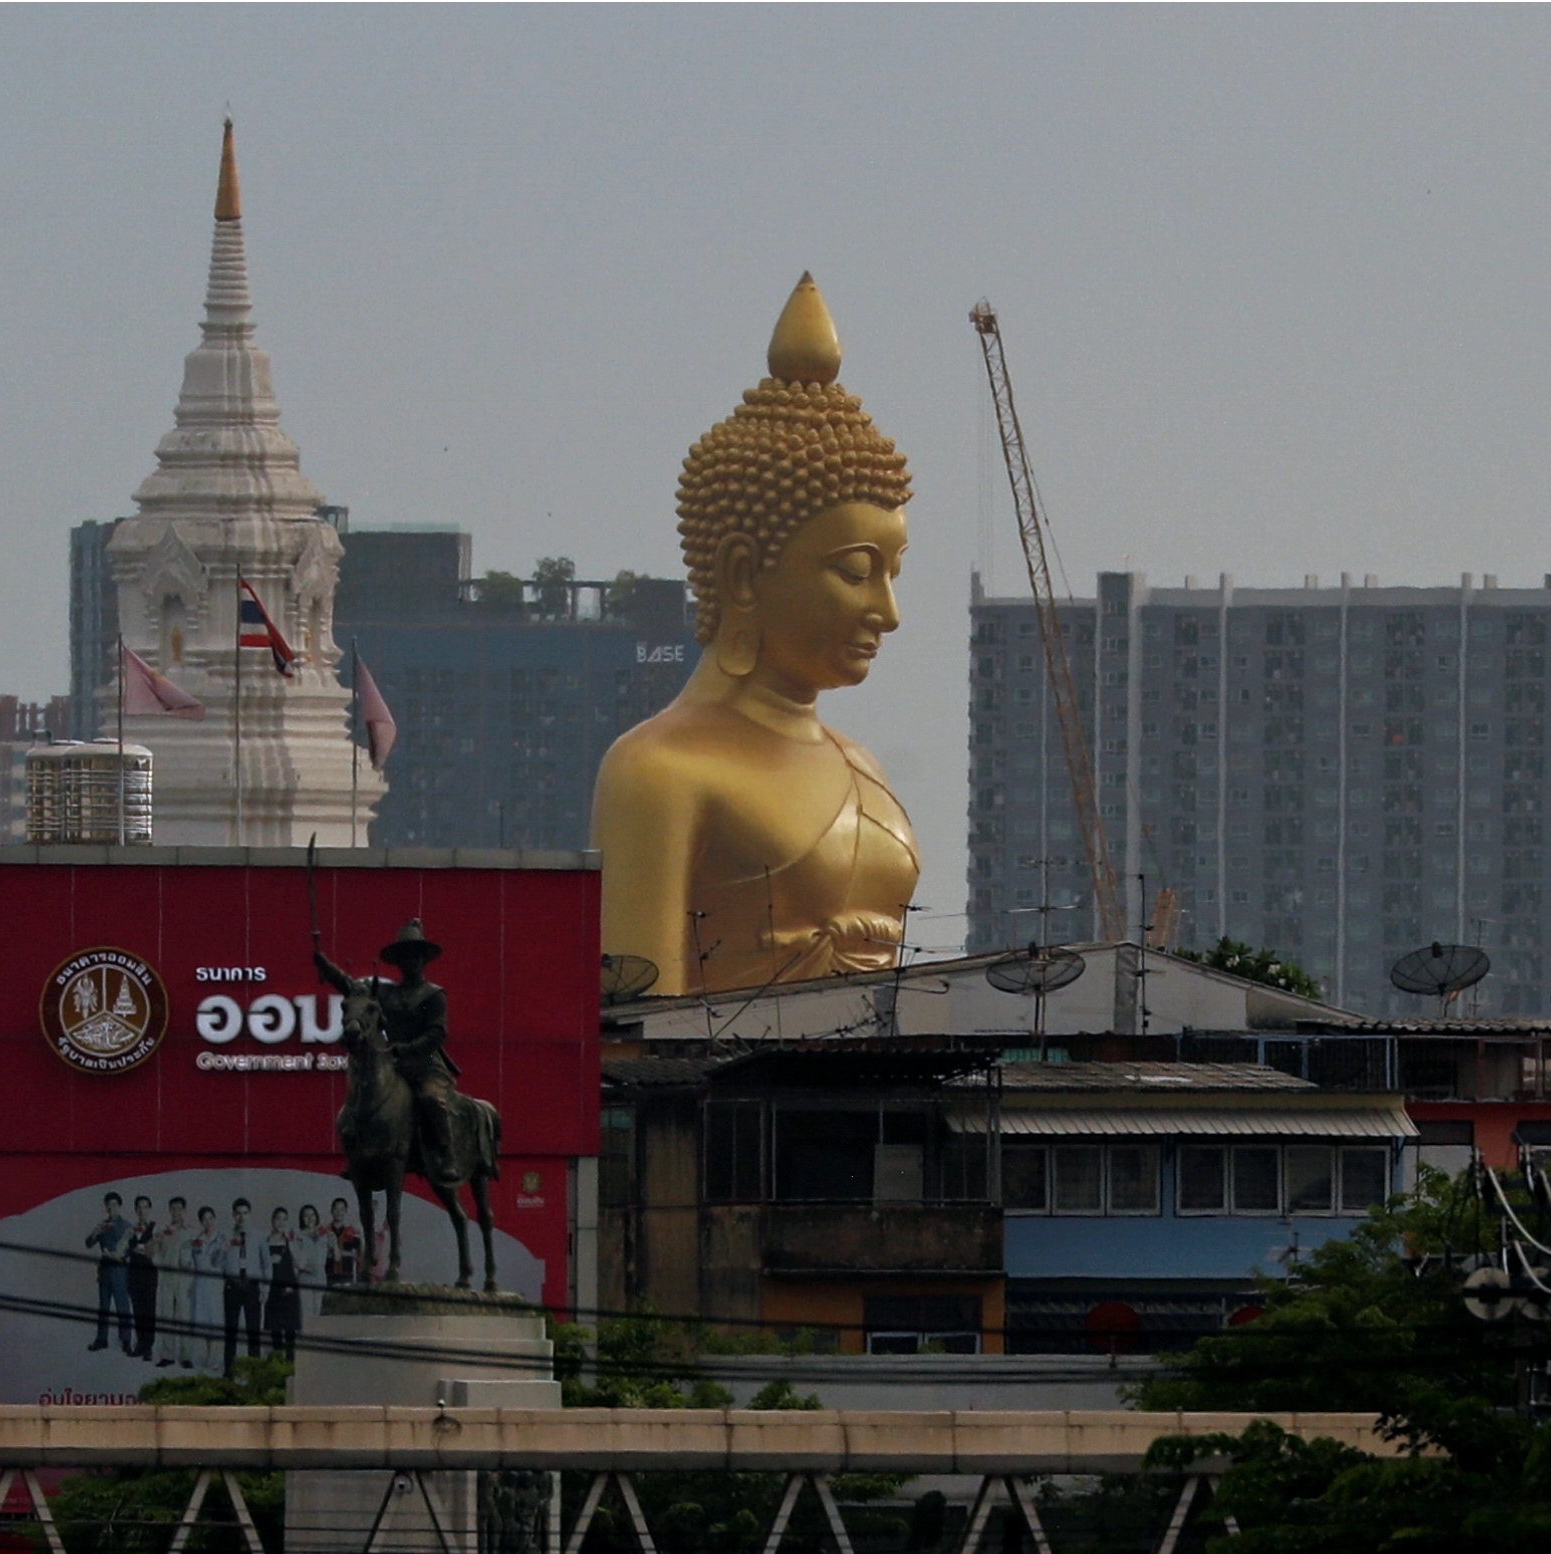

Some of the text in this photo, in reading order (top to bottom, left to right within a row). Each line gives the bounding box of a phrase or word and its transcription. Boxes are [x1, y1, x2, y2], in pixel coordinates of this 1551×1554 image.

[636, 645, 685, 663] BASE
[195, 965, 267, 982] ธนาคาร
[195, 993, 345, 1044] ออม
[195, 1050, 314, 1072] Government
